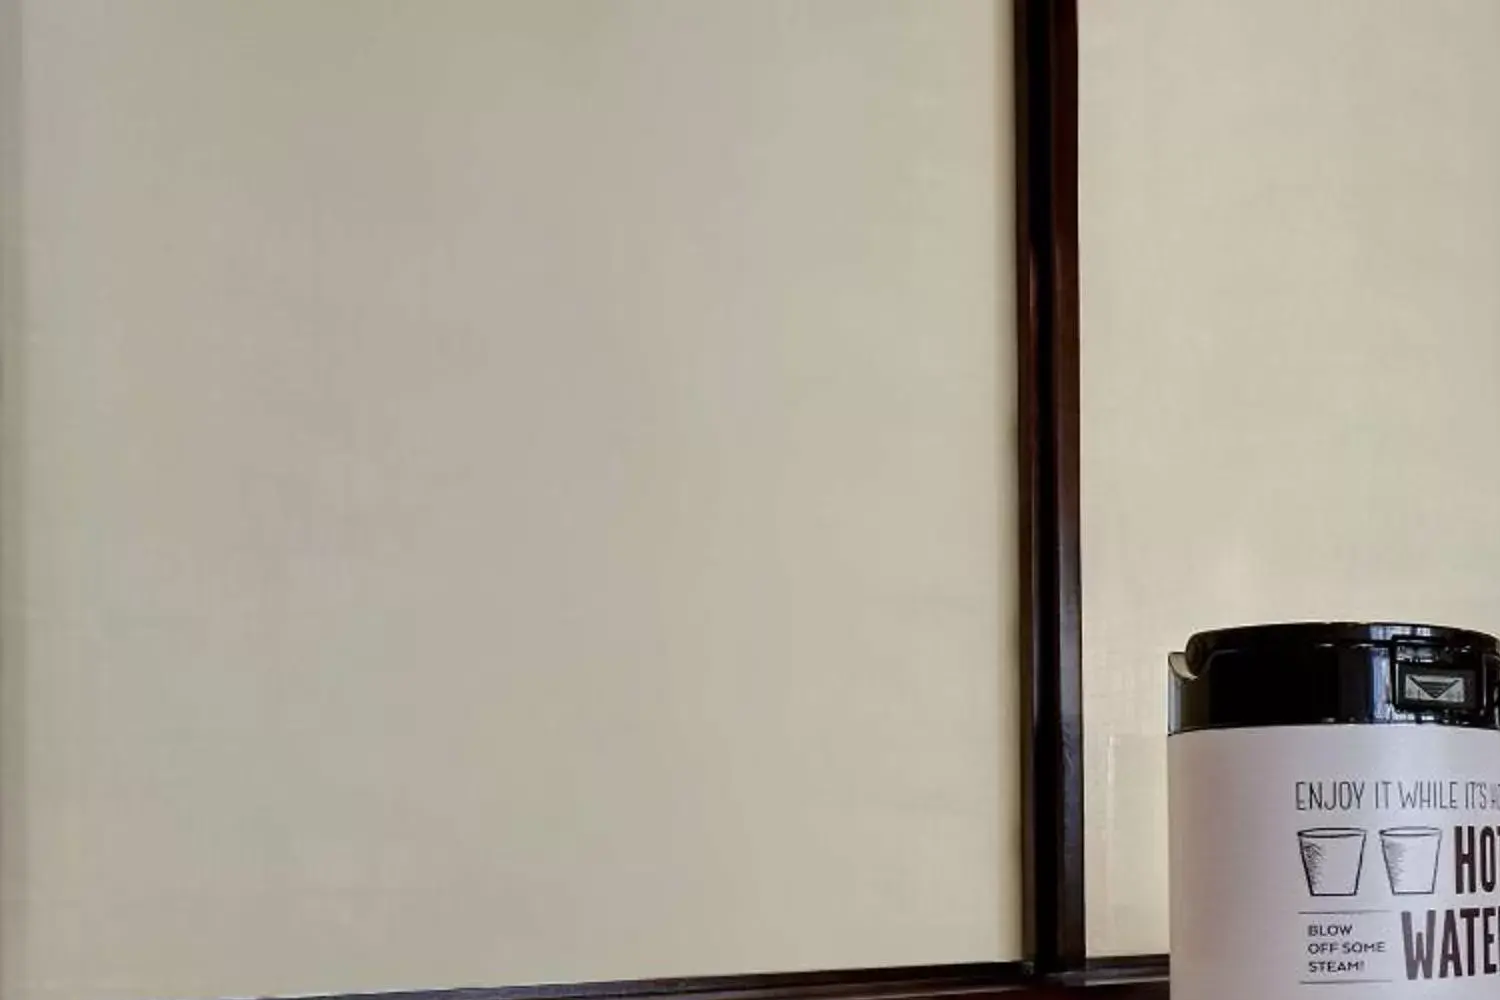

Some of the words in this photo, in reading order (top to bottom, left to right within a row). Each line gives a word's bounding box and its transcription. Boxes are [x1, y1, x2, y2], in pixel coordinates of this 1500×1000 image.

[1295, 781, 1365, 811] ENJOY
[1375, 781, 1392, 810] IT
[1398, 780, 1458, 810] WHILE
[1307, 924, 1353, 937] BLOW
[1307, 942, 1340, 955] OFF
[1341, 941, 1386, 954] SOME
[1308, 960, 1365, 973] STEAM!
